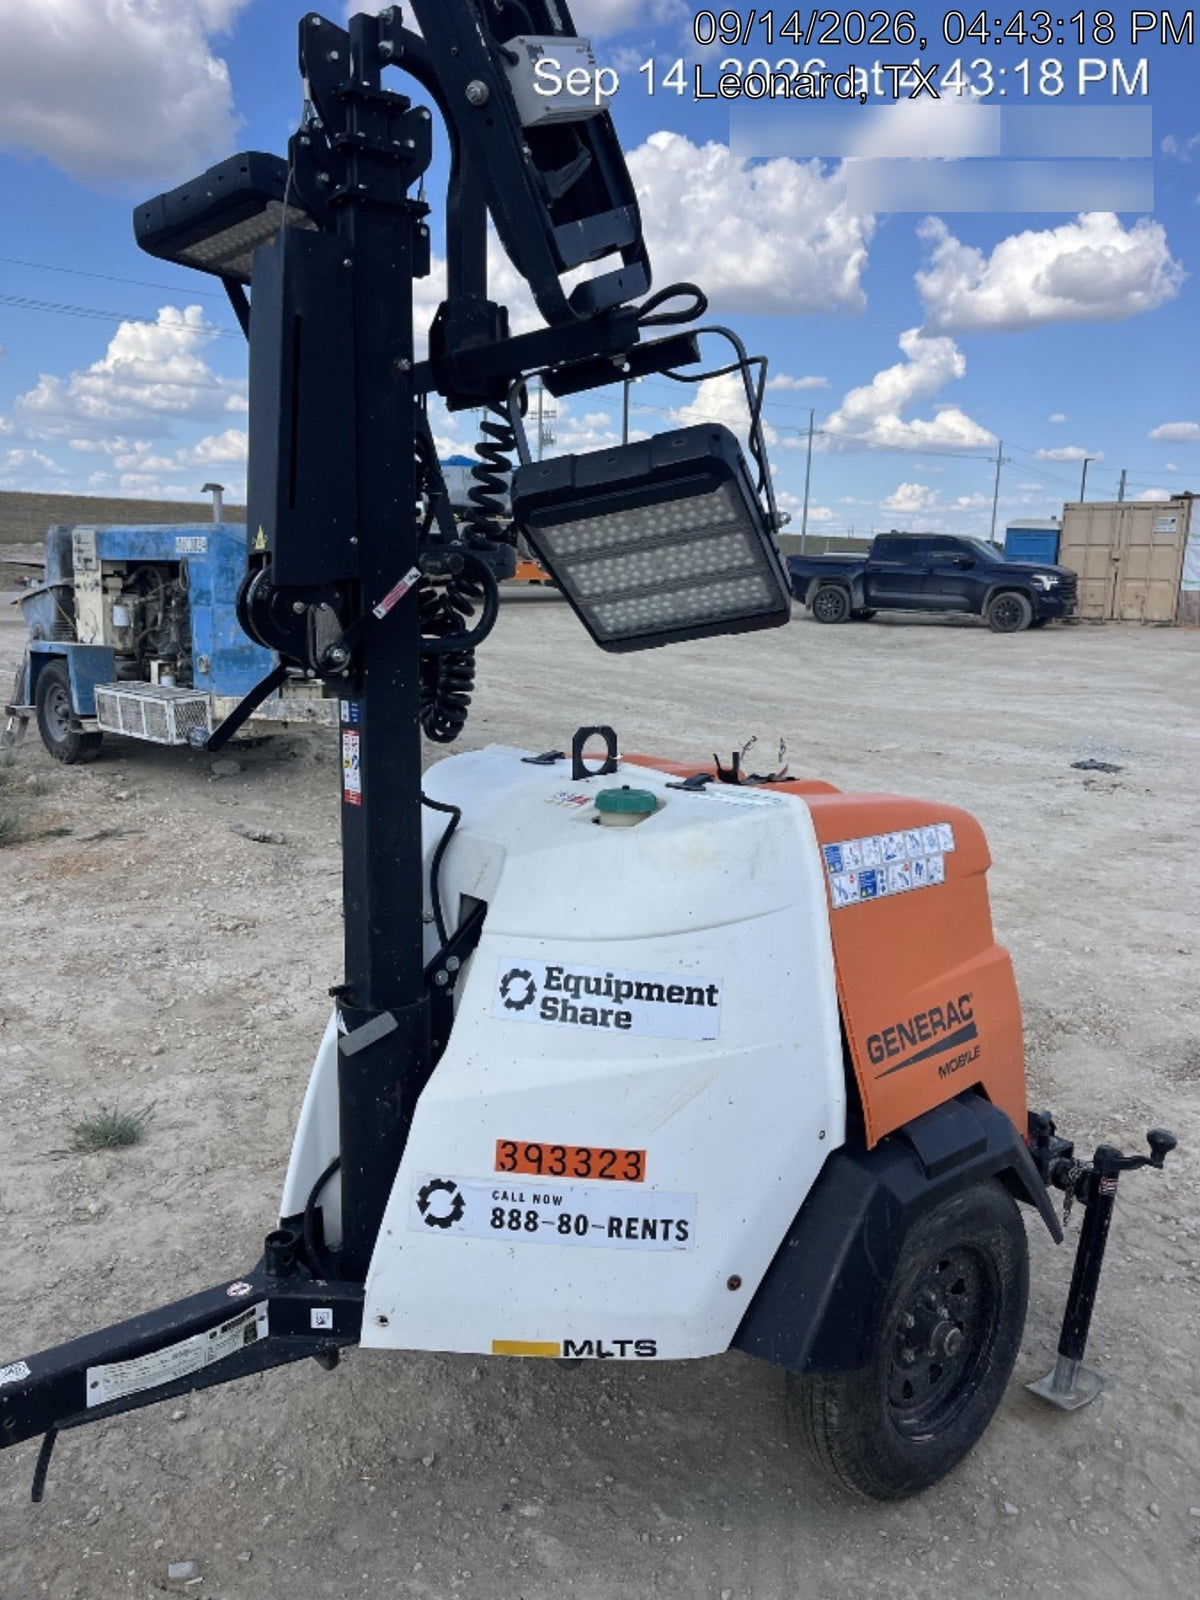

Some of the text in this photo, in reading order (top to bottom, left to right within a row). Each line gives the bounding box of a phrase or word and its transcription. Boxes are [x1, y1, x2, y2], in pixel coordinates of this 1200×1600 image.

[543, 966, 719, 1007] Equipment
[539, 996, 633, 1030] Share
[866, 994, 974, 1066] GENERAC
[937, 1044, 981, 1080] MOBILE
[499, 1140, 642, 1181] 393323
[491, 1190, 563, 1206] CALL NOW
[489, 1206, 690, 1242] 888-80-RENTS
[563, 1339, 658, 1359] MLTS
